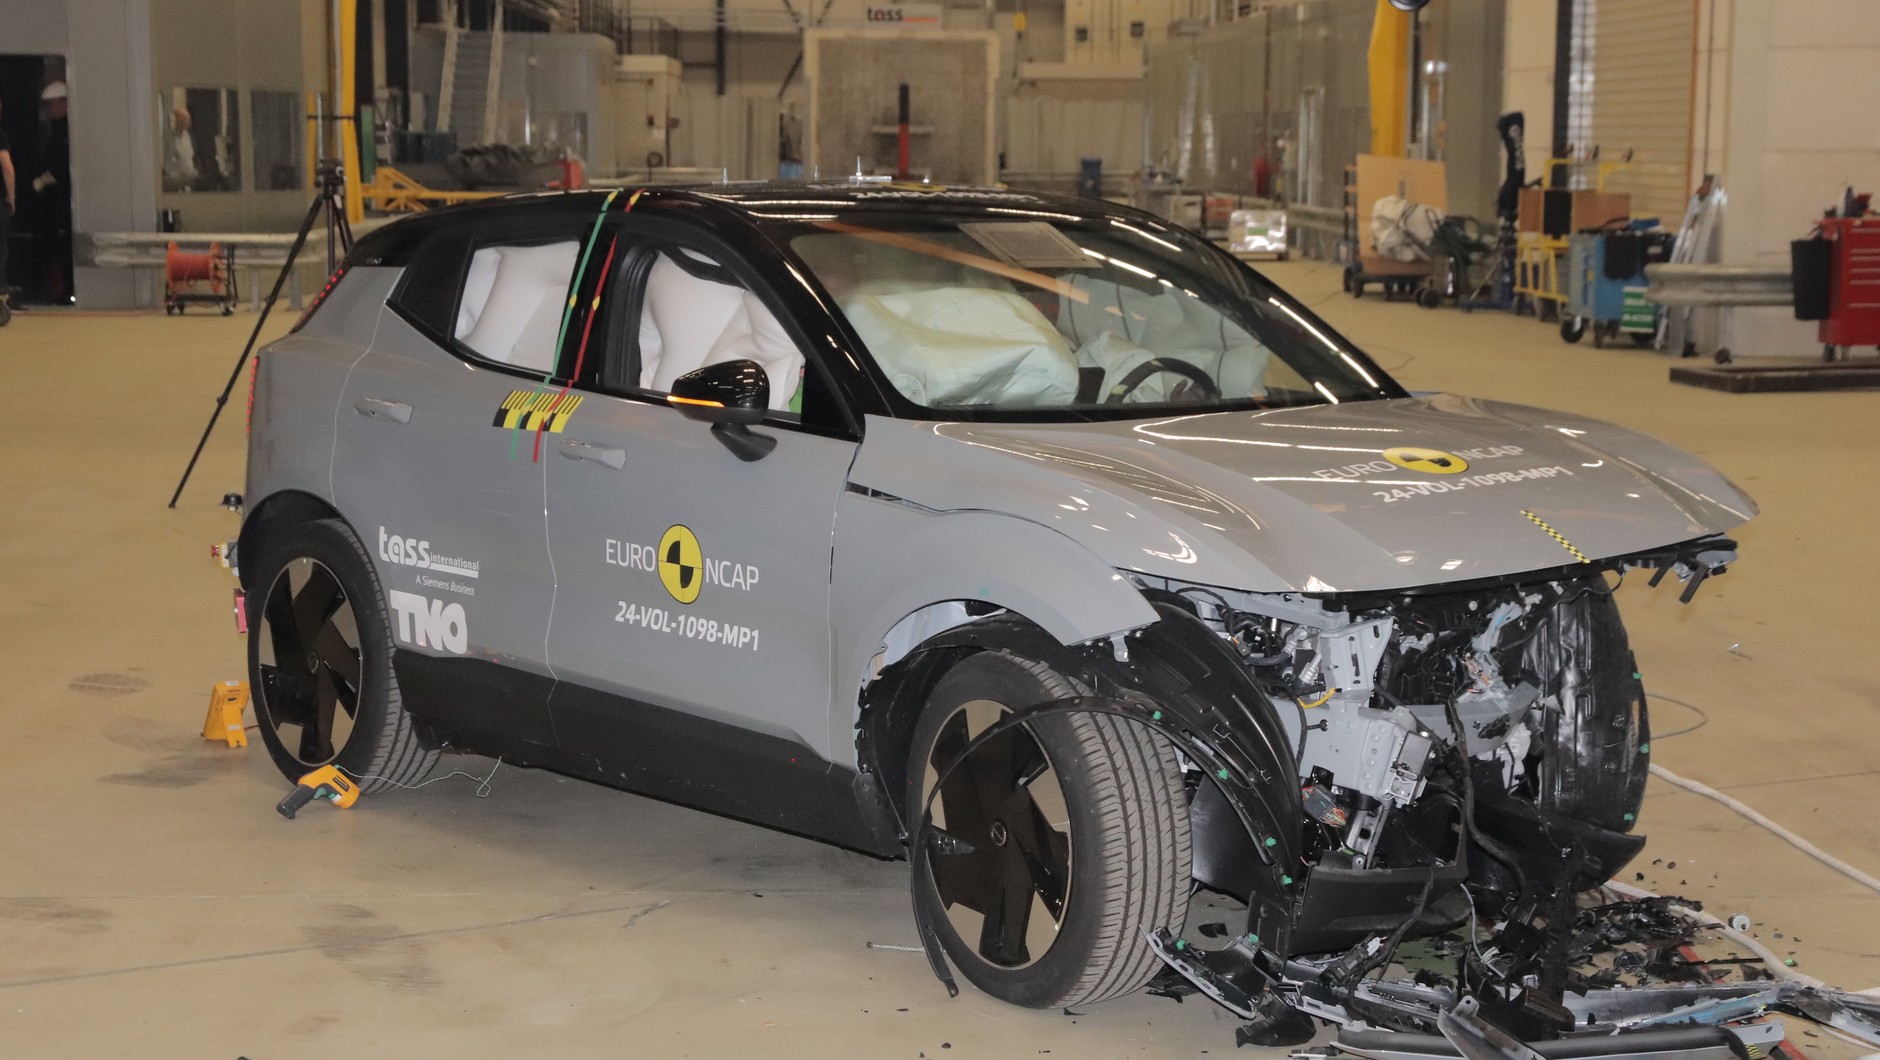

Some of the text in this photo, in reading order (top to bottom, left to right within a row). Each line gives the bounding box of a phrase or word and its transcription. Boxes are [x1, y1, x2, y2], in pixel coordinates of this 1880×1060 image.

[867, 6, 903, 22] tass
[1312, 445, 1524, 480] EURO NCAP
[1372, 465, 1574, 503] 24-VOL-1098-MP1
[379, 526, 479, 571] tass international
[606, 538, 759, 591] EURO NCAP
[415, 575, 475, 596] A Siemens Business
[390, 589, 468, 655] TNO
[615, 601, 760, 651] 24-VOL-1098-MP1
